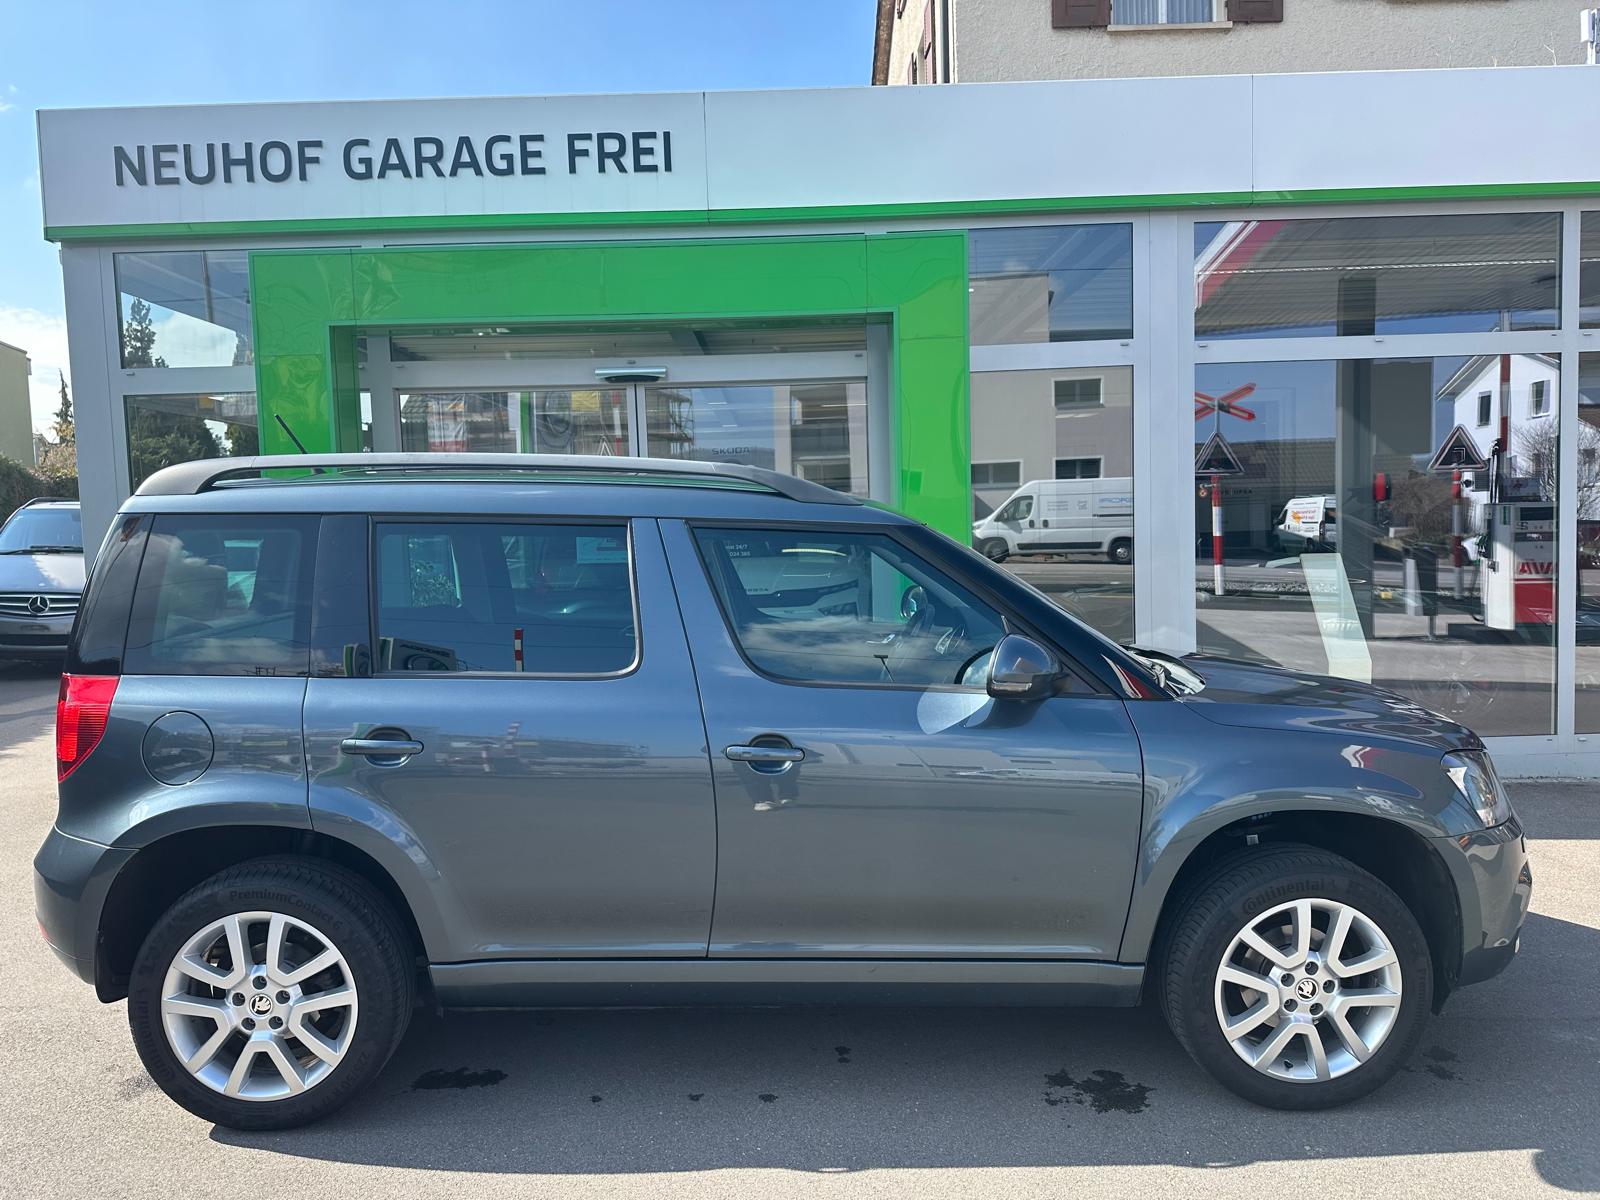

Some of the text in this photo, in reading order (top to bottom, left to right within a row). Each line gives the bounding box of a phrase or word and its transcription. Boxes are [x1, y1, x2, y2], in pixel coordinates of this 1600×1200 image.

[114, 131, 673, 188] NEUHOF GARAGE FREI
[1241, 878, 1325, 914] Continental
